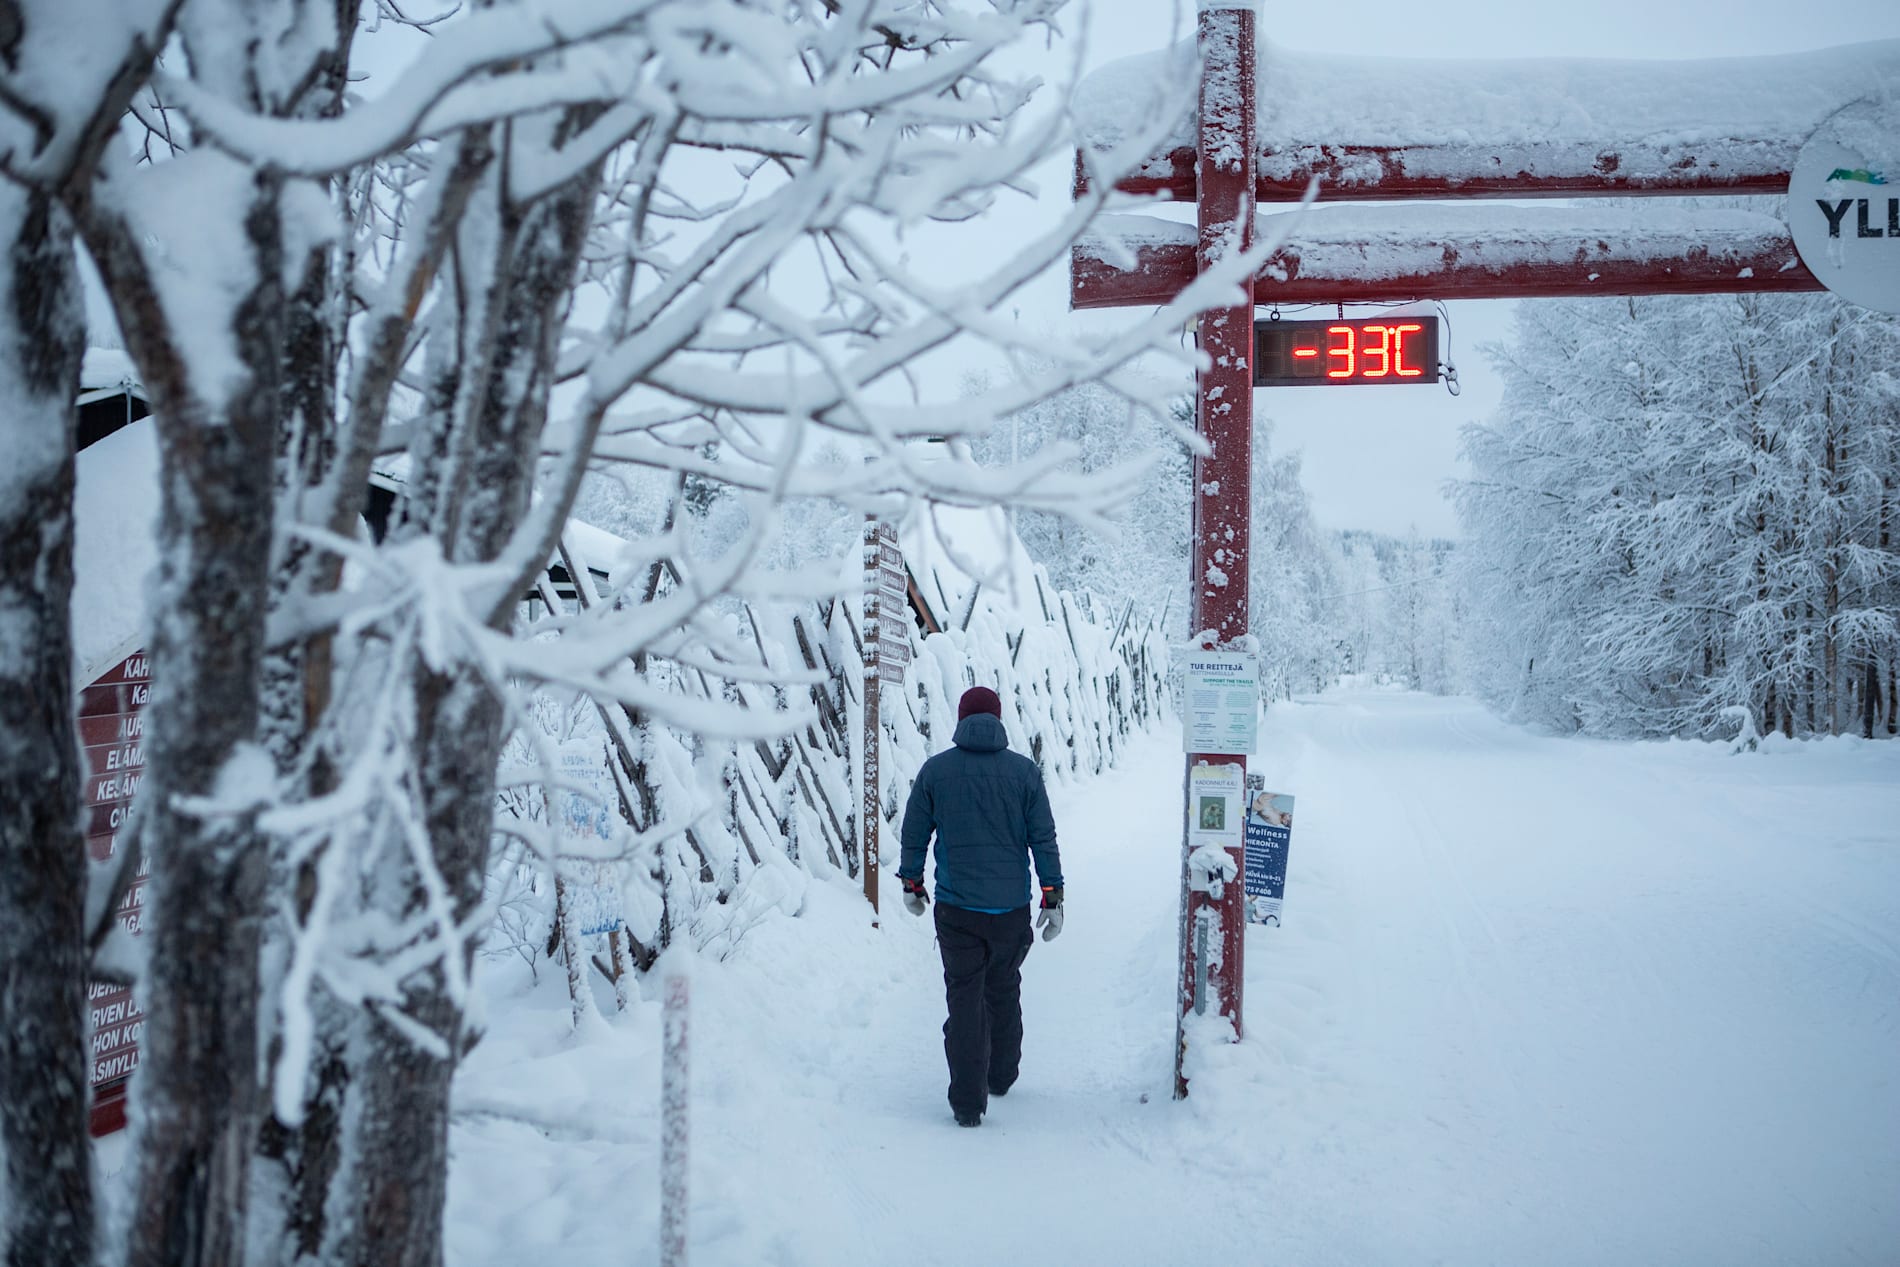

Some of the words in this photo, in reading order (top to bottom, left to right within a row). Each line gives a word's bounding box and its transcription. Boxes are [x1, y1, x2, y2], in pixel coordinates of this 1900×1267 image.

[1190, 663, 1205, 671] TUE
[1206, 662, 1244, 672] REITTEJÄ
[1247, 826, 1288, 839] Wellness
[1245, 838, 1280, 849] HIERONTA
